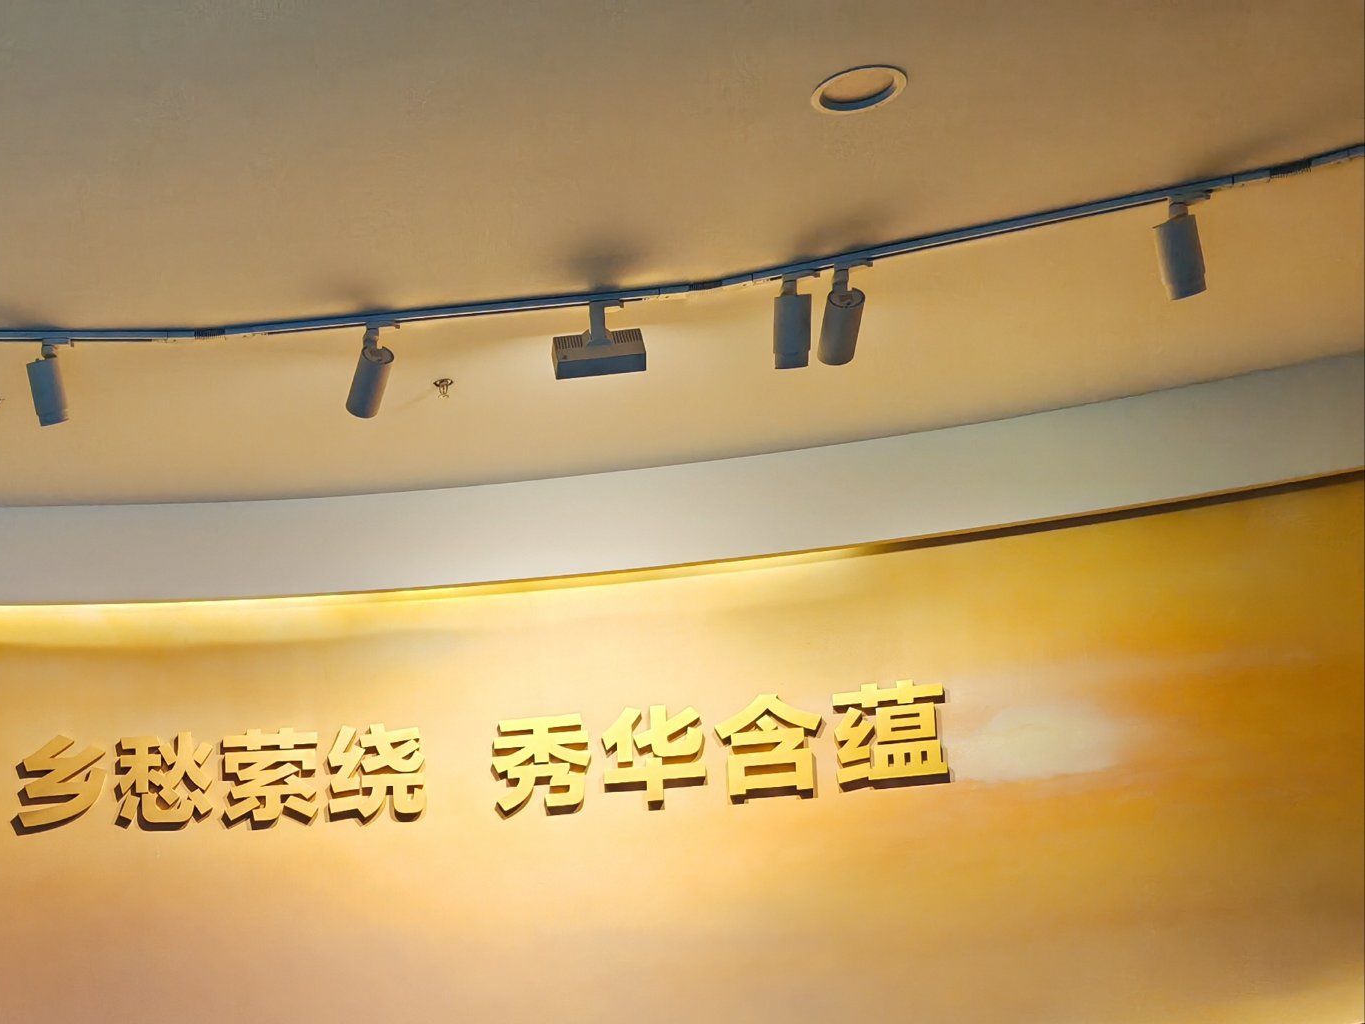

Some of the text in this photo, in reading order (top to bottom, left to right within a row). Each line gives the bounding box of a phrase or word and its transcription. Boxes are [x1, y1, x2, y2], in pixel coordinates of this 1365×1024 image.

[12, 680, 948, 833] 乡愁萦绕 秀华含蕴
